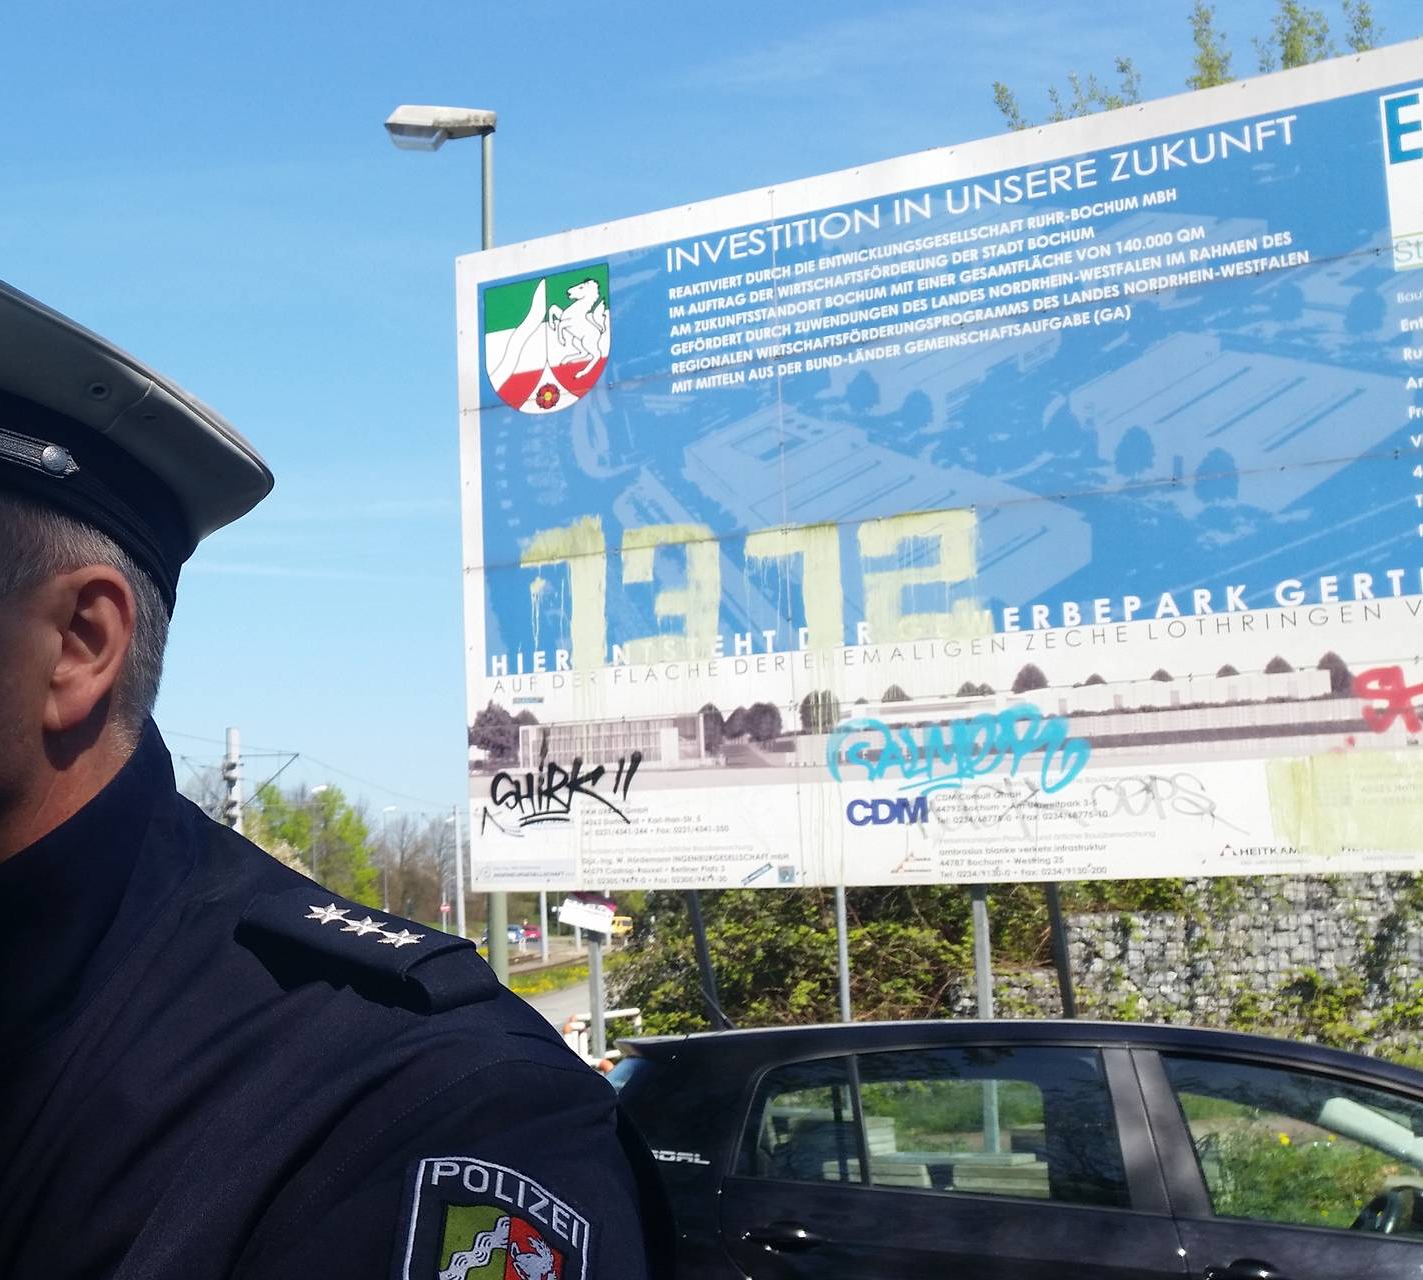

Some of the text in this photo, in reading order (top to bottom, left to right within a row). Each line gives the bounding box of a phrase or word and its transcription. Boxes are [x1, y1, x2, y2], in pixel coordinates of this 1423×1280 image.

[666, 115, 1297, 273] INVESTITION IN UNSERE ZUKUNFT
[669, 188, 1177, 300] REAKTIVIERT DURCH DIE ENTWICKLUNGSGESELLSCHAFT RUHR-BOCHUM MBH
[669, 227, 1095, 319] IM AUFTRAG DER WIRTSCHAFTSFÖRDERUNG DER STADT BOCHUM
[670, 226, 1206, 337] AM ZUKUNFTSSTANDORT BOCHUM MIT EINER GESAMTFLÄCHE VON 140.000 QM
[670, 231, 1292, 357] GEFÖRDERT DURCH ZUWENDUNGEN DES LANDES NORDRHEIN-WESTFALEN IM RAHMEN DES
[671, 250, 1309, 376] REGIONALEN WIRTSCHAFTSFÖRDERUNGSPROGRAMMS DES LANDES NORDRHEIN-WESTFALEN
[671, 304, 1132, 394] MIT MITTELN AUS DER BUND-LÄNDER GEMEINSCHAFTSAUFGABE (GA)
[491, 648, 572, 677] HIER
[1276, 567, 1423, 607] GERT
[493, 678, 538, 694] AUF
[734, 655, 785, 675] DER
[1025, 625, 1129, 651] ZECHE
[1148, 602, 1381, 640] LOTHRINGEN
[846, 796, 929, 827] CDM
[430, 1161, 579, 1248] POLIZEI
